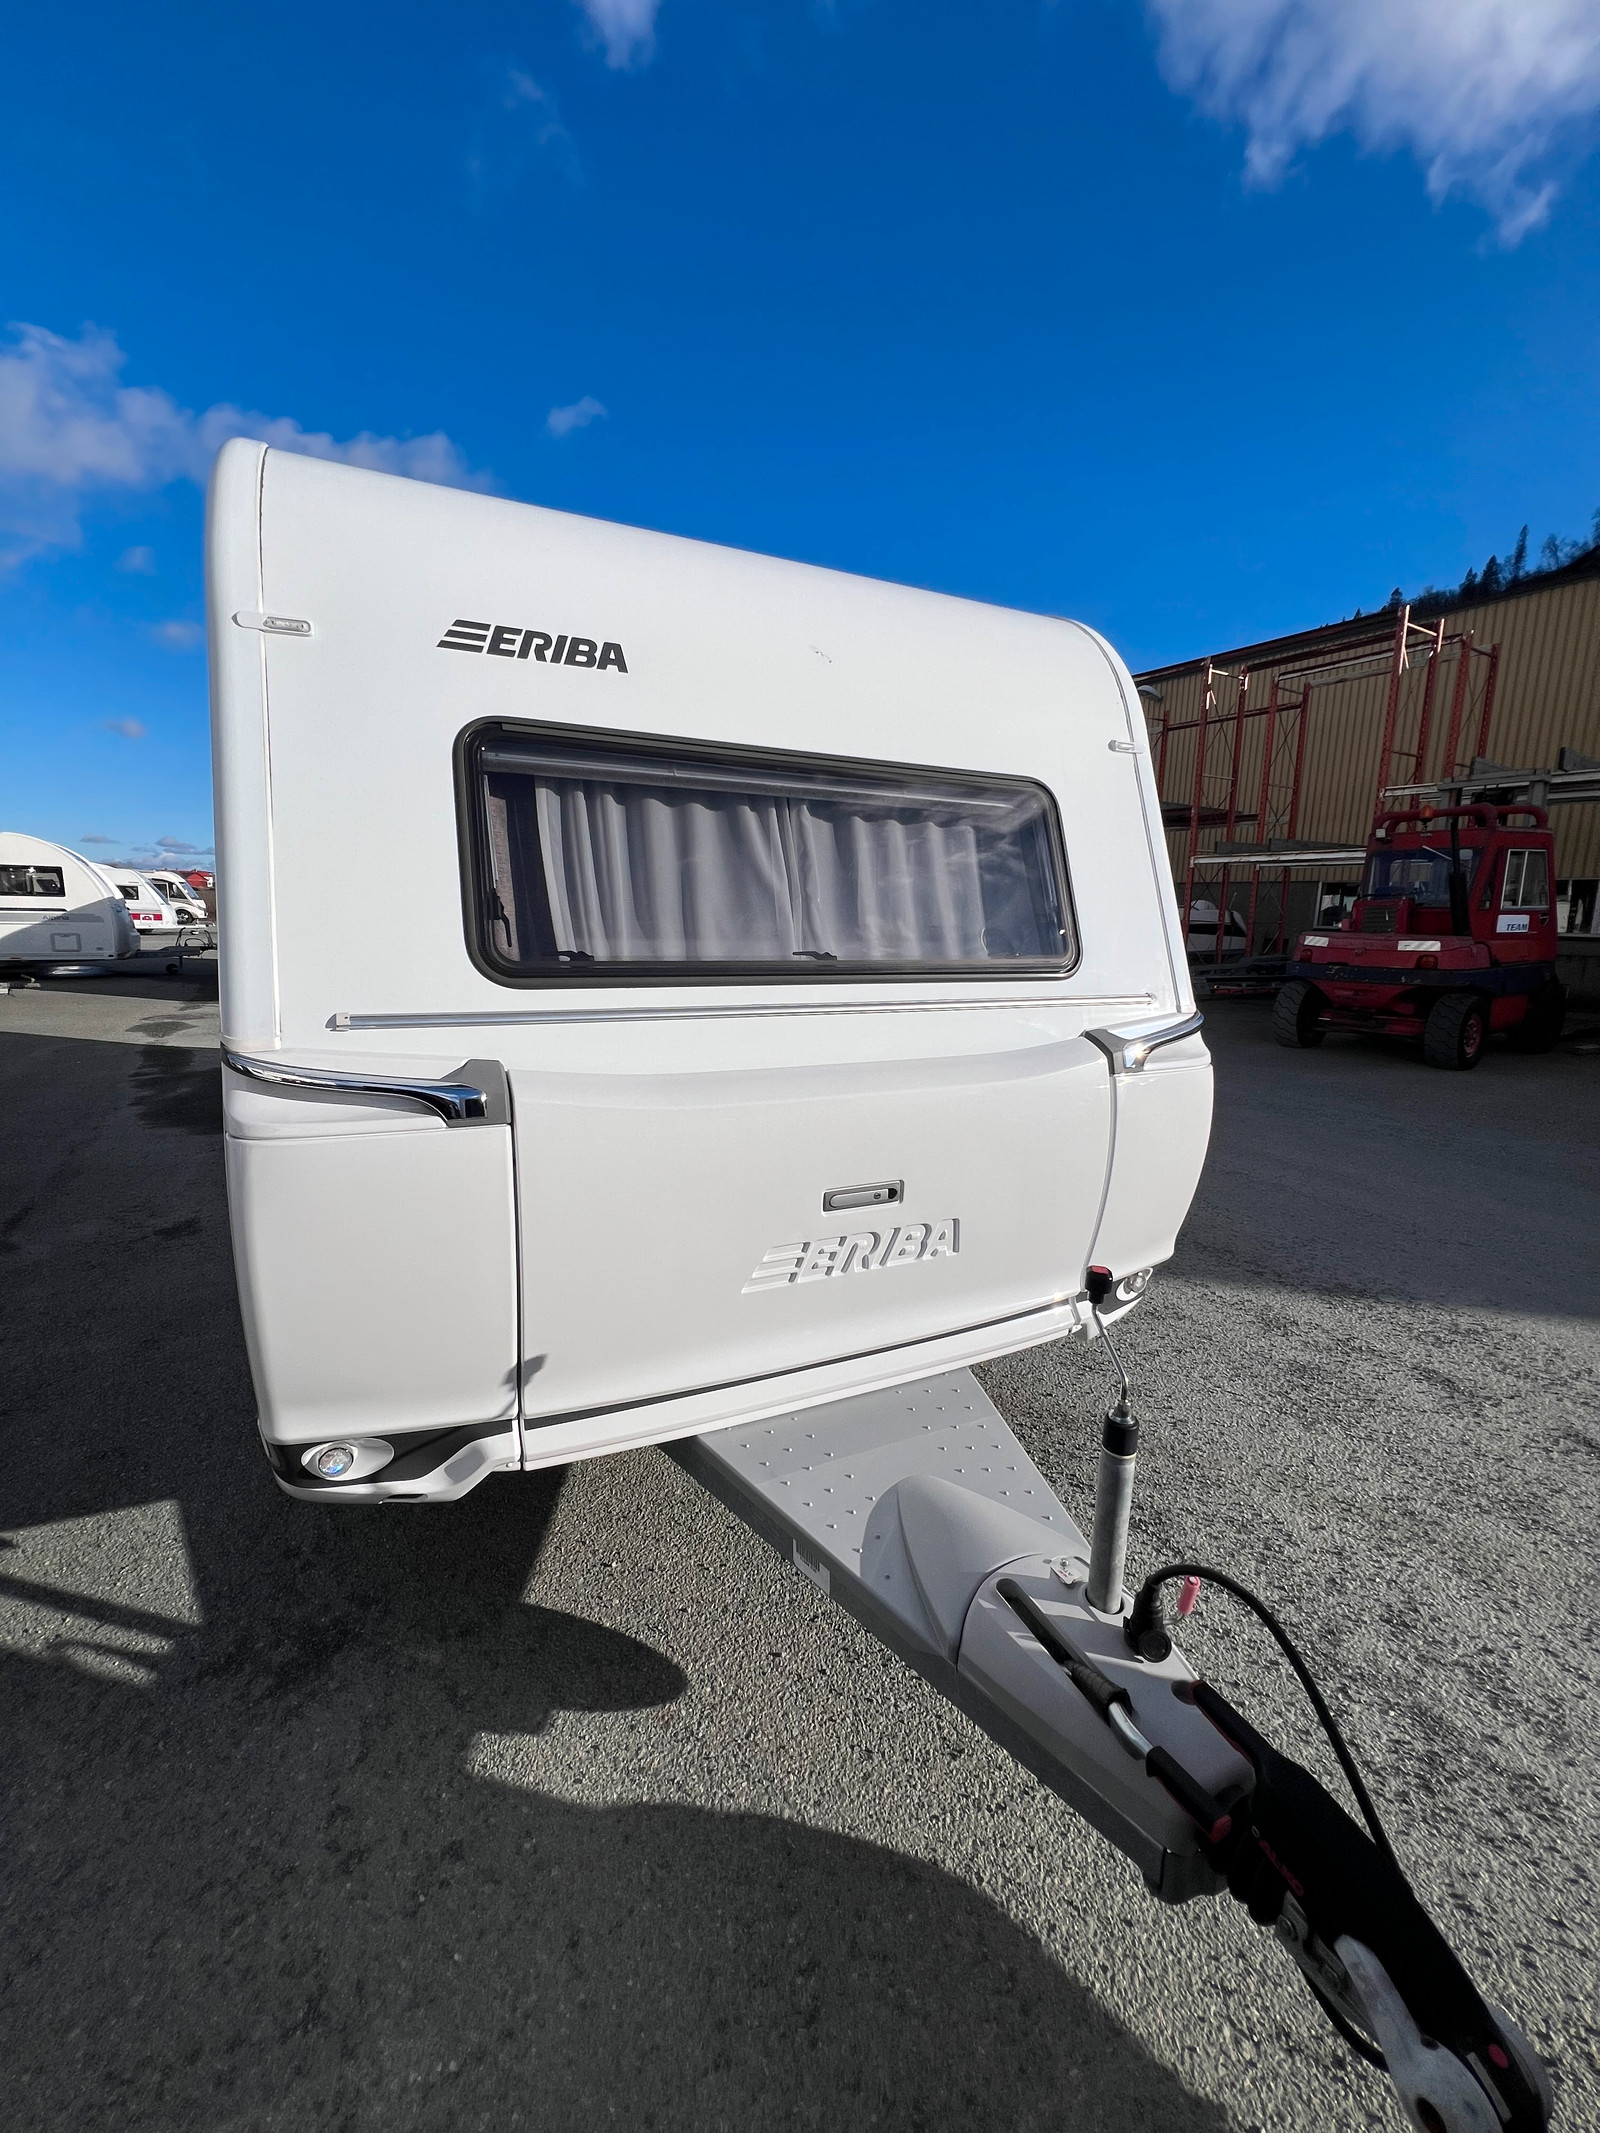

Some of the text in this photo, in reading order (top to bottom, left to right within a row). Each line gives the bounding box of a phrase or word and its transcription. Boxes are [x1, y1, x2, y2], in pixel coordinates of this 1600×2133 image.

[486, 624, 629, 674] ERIBA
[1506, 923, 1528, 931] TEAM
[797, 1217, 960, 1284] ERIBA
